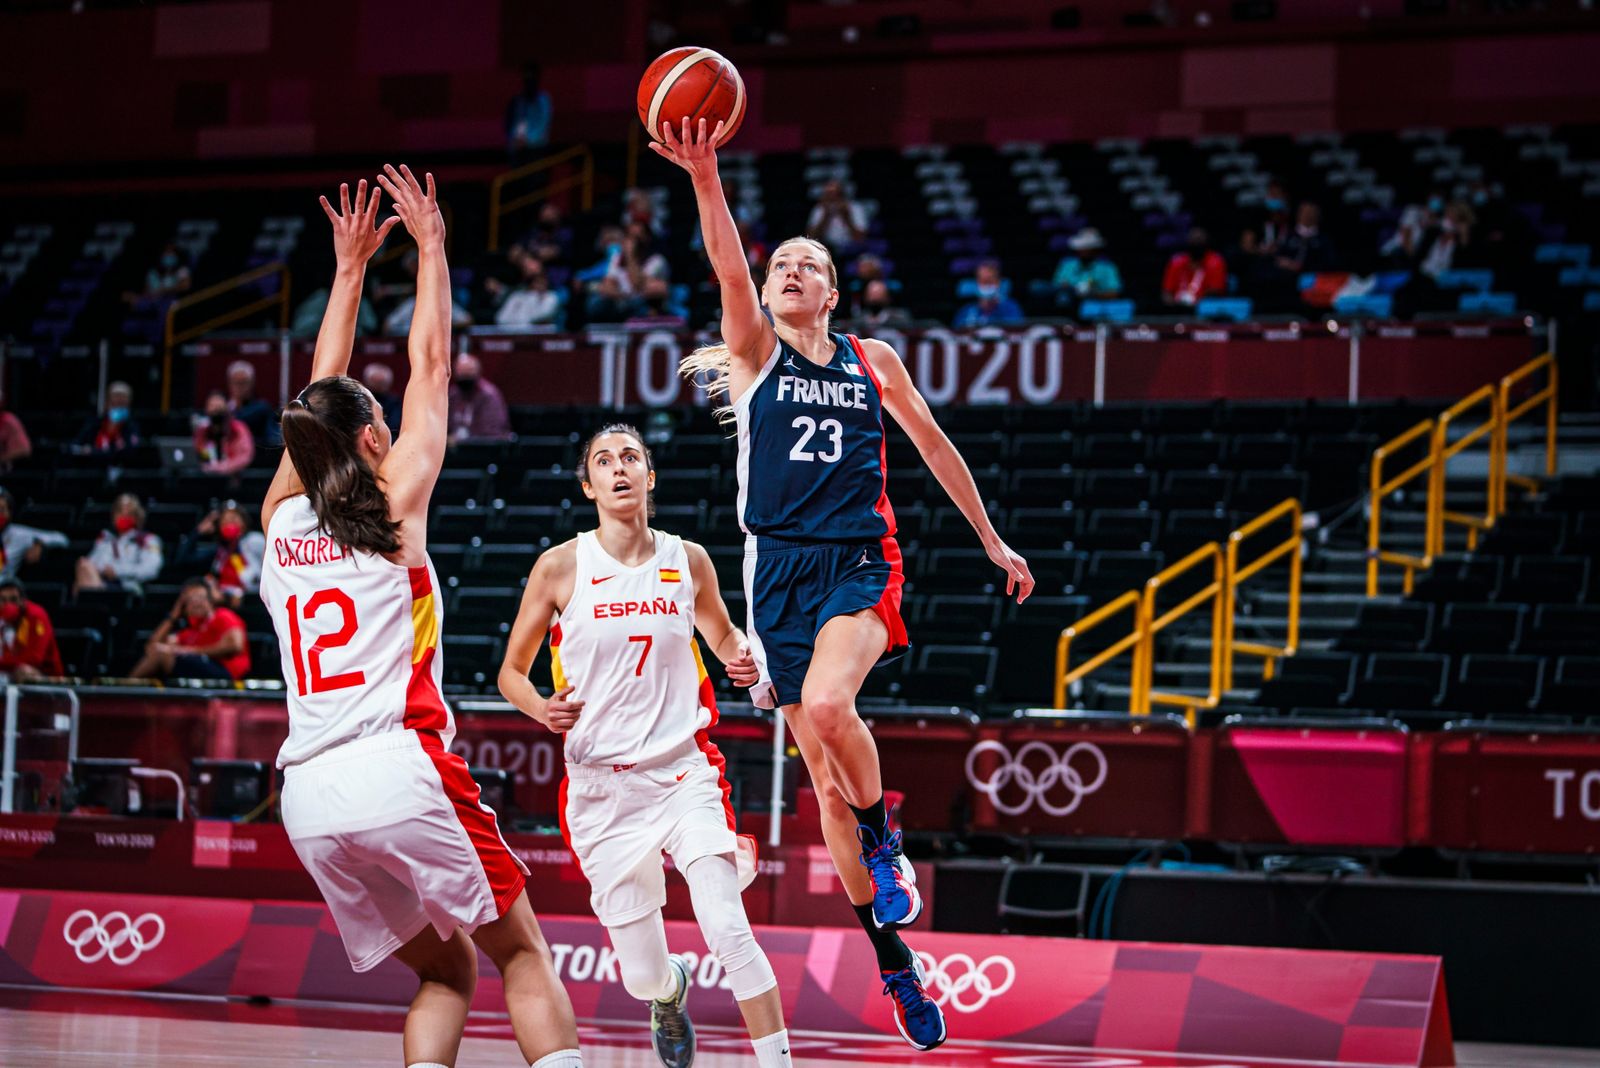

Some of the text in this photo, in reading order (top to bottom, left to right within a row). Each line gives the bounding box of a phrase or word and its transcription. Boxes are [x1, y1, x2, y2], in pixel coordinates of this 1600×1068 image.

[776, 375, 868, 411] FRANCE
[789, 415, 843, 463] 23
[594, 597, 679, 619] ESPAÑA
[286, 587, 366, 697] 12
[629, 635, 653, 676] 7
[551, 943, 620, 983] TOK
